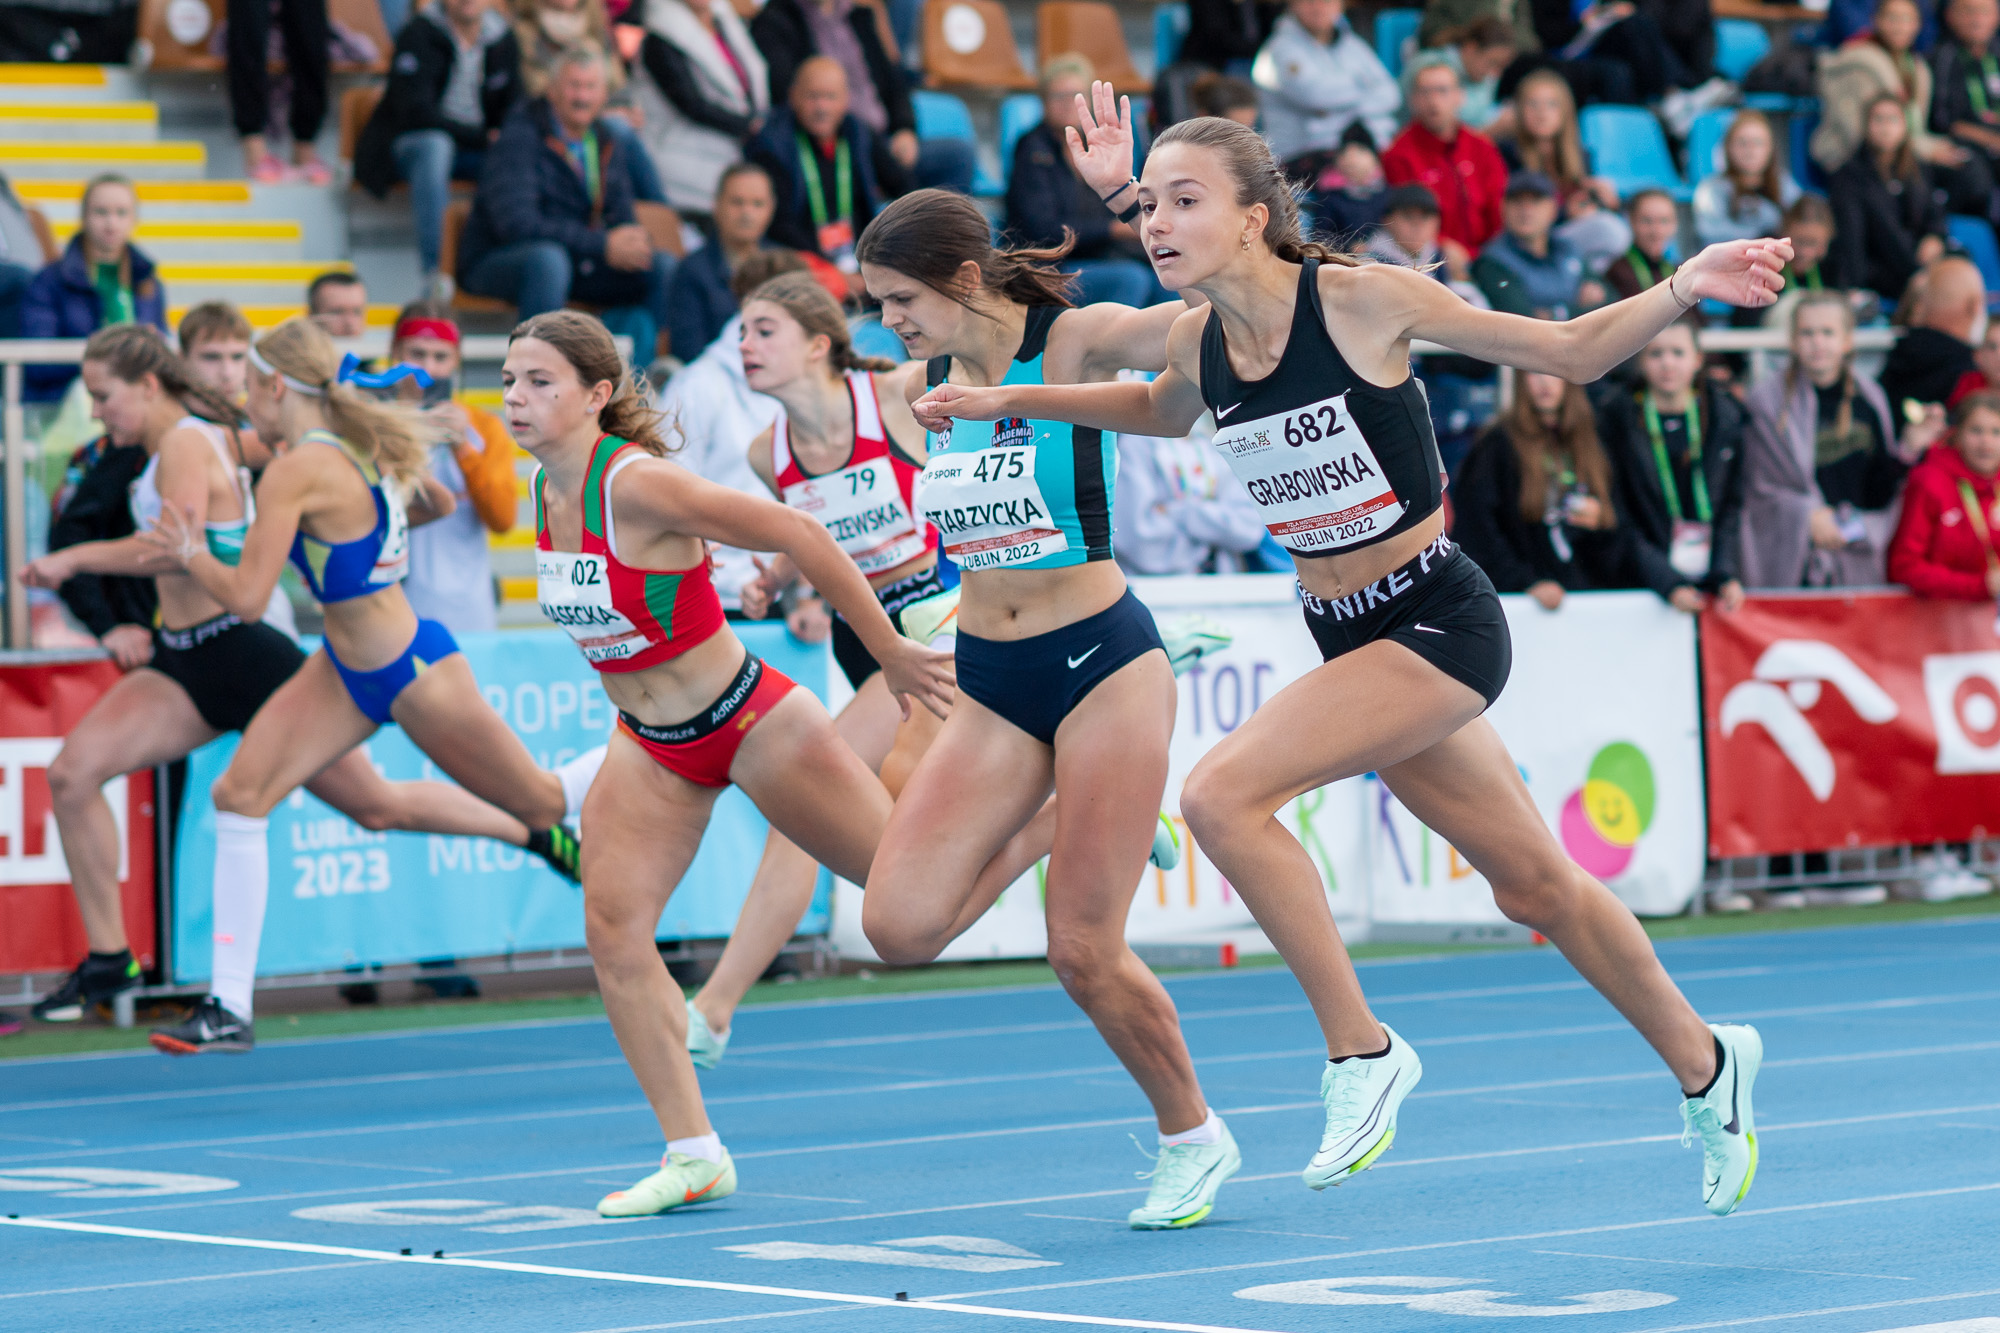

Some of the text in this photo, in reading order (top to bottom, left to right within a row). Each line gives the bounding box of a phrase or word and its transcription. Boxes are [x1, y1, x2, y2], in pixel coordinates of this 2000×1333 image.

[991, 427, 1032, 446] AKADEMIA
[1284, 405, 1346, 448] 682
[844, 468, 876, 496] 79
[934, 468, 962, 480] SPORT
[973, 451, 1025, 482] 475
[1248, 452, 1376, 507] GRABOWSKA
[1291, 517, 1377, 548] LUBLIN 2022
[963, 550, 1001, 569] LUBLIN
[1004, 542, 1041, 562] 2022
[1331, 570, 1414, 621] NIKE
[601, 643, 631, 659] 2022
[427, 834, 547, 876] MŁO
[292, 848, 391, 899] 2023
